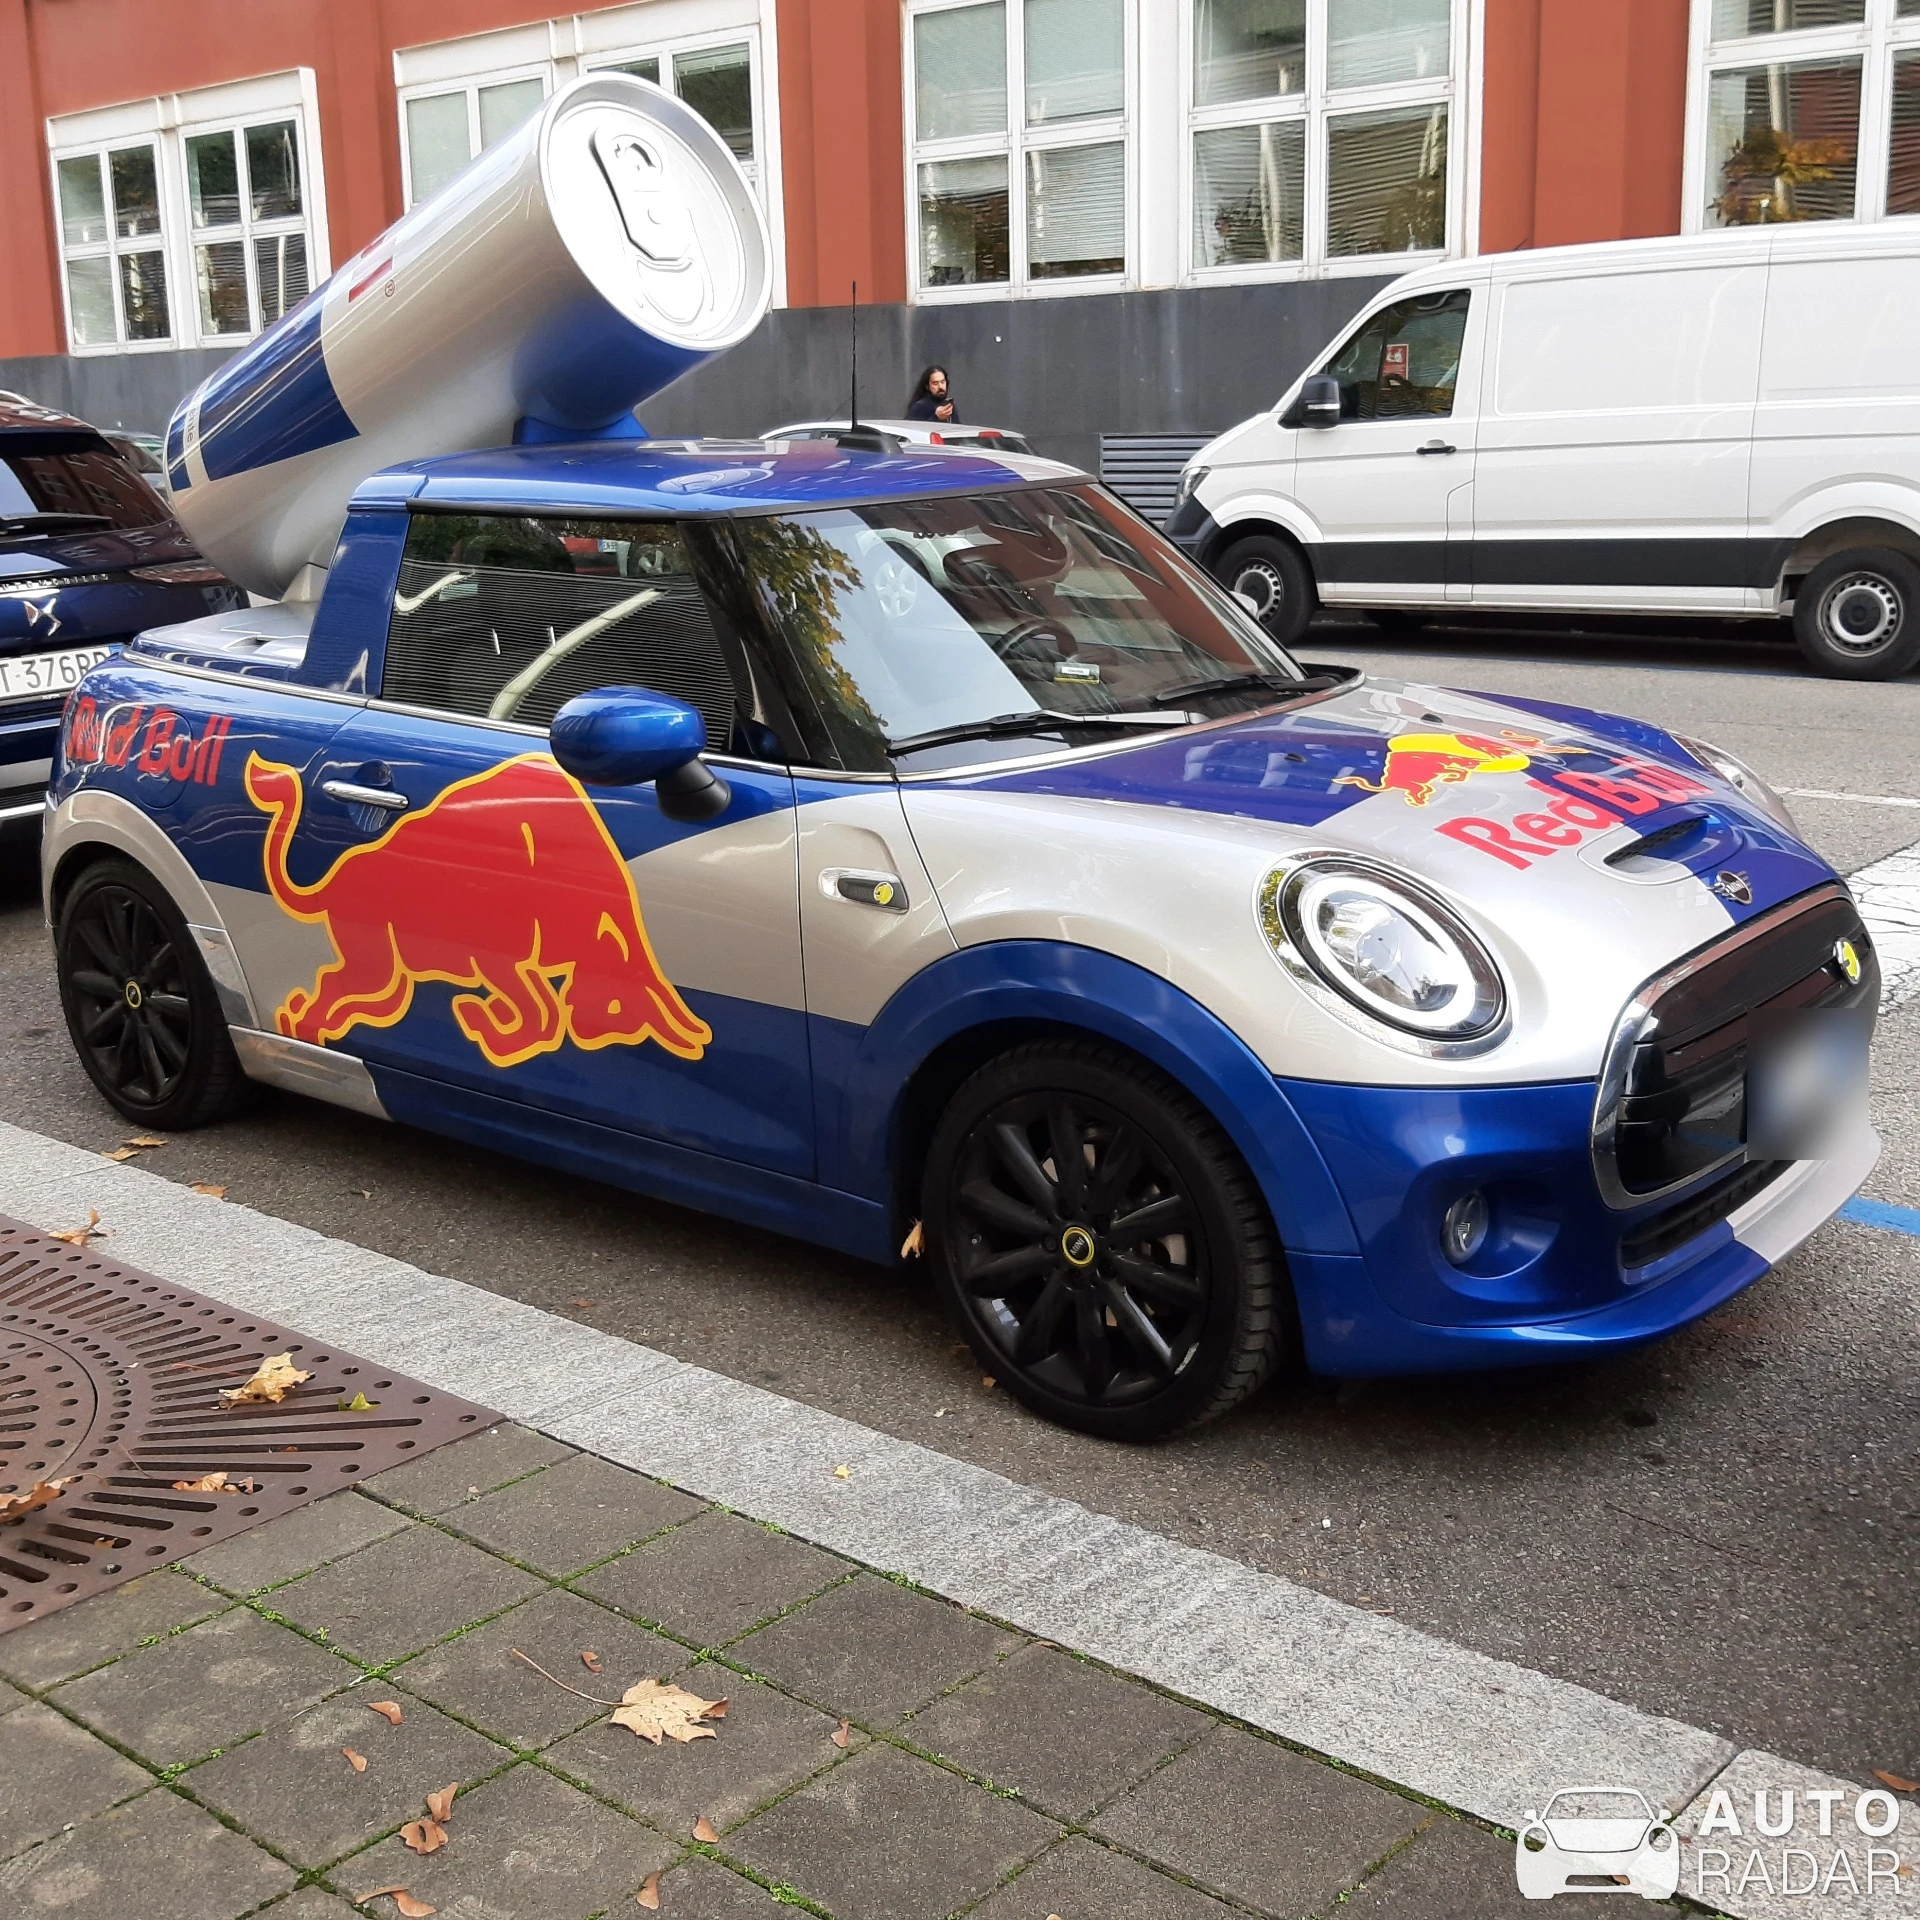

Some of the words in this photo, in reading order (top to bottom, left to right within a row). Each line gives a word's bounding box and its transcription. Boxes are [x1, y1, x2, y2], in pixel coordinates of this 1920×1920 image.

[67, 695, 144, 767] Red
[137, 706, 232, 787] Bull
[1434, 779, 1625, 871] Red
[1553, 756, 1714, 815] Bull
